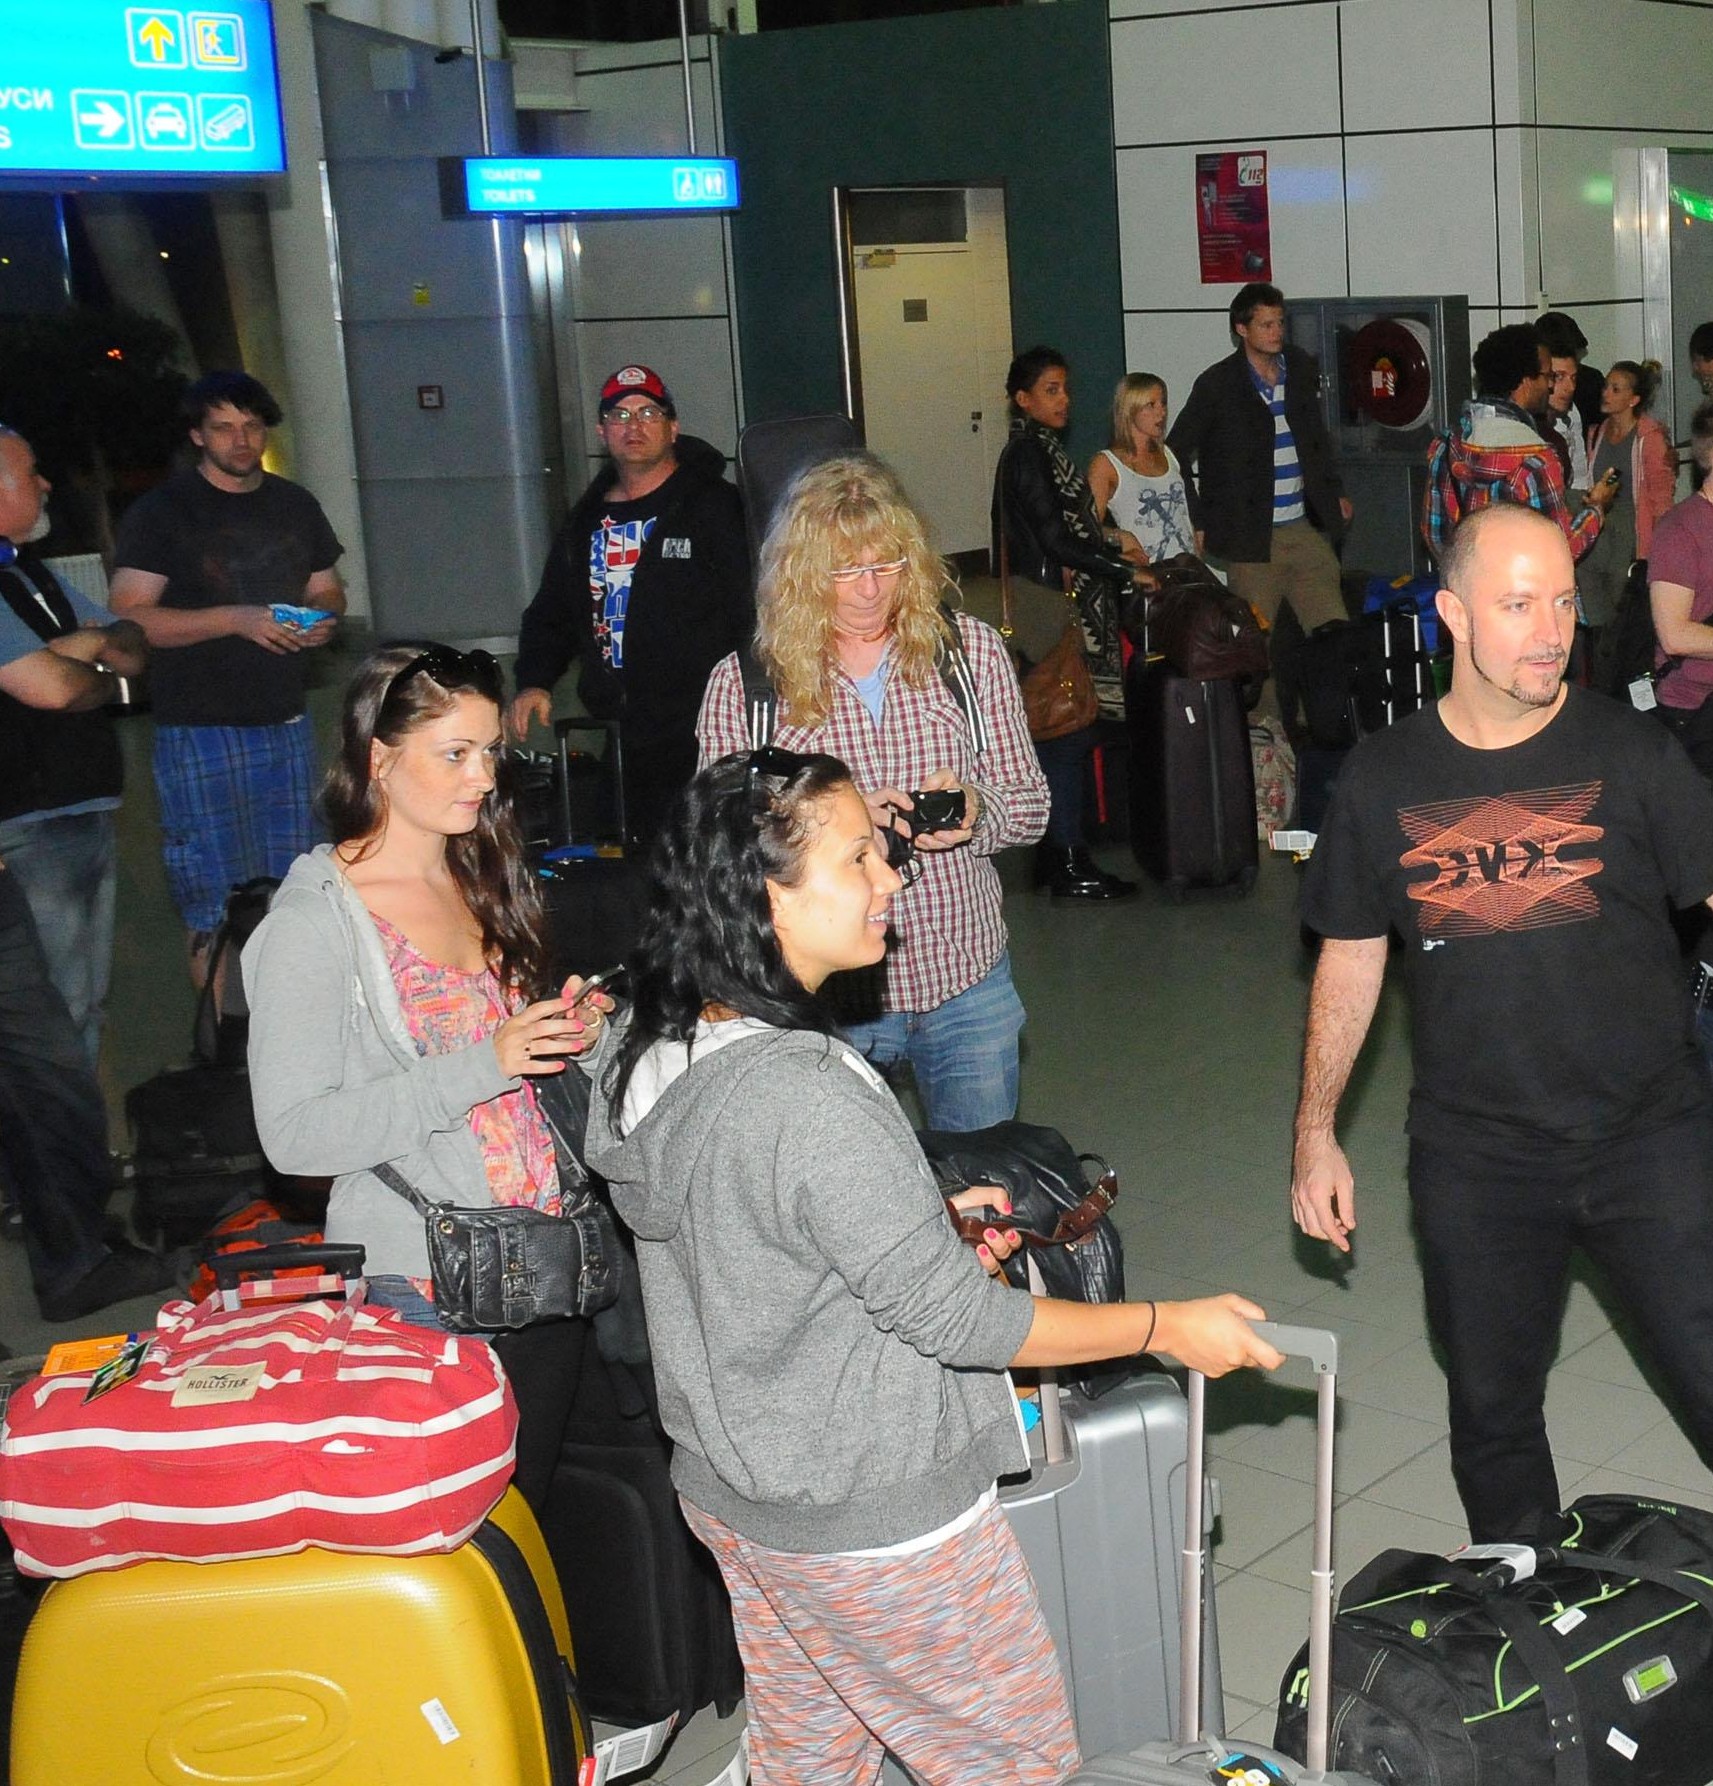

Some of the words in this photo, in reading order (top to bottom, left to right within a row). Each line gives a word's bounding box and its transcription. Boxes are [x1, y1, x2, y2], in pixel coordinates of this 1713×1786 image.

[1248, 168, 1263, 180] 112
[481, 188, 536, 203] TOILETS
[187, 1378, 249, 1389] HOLLISTER
